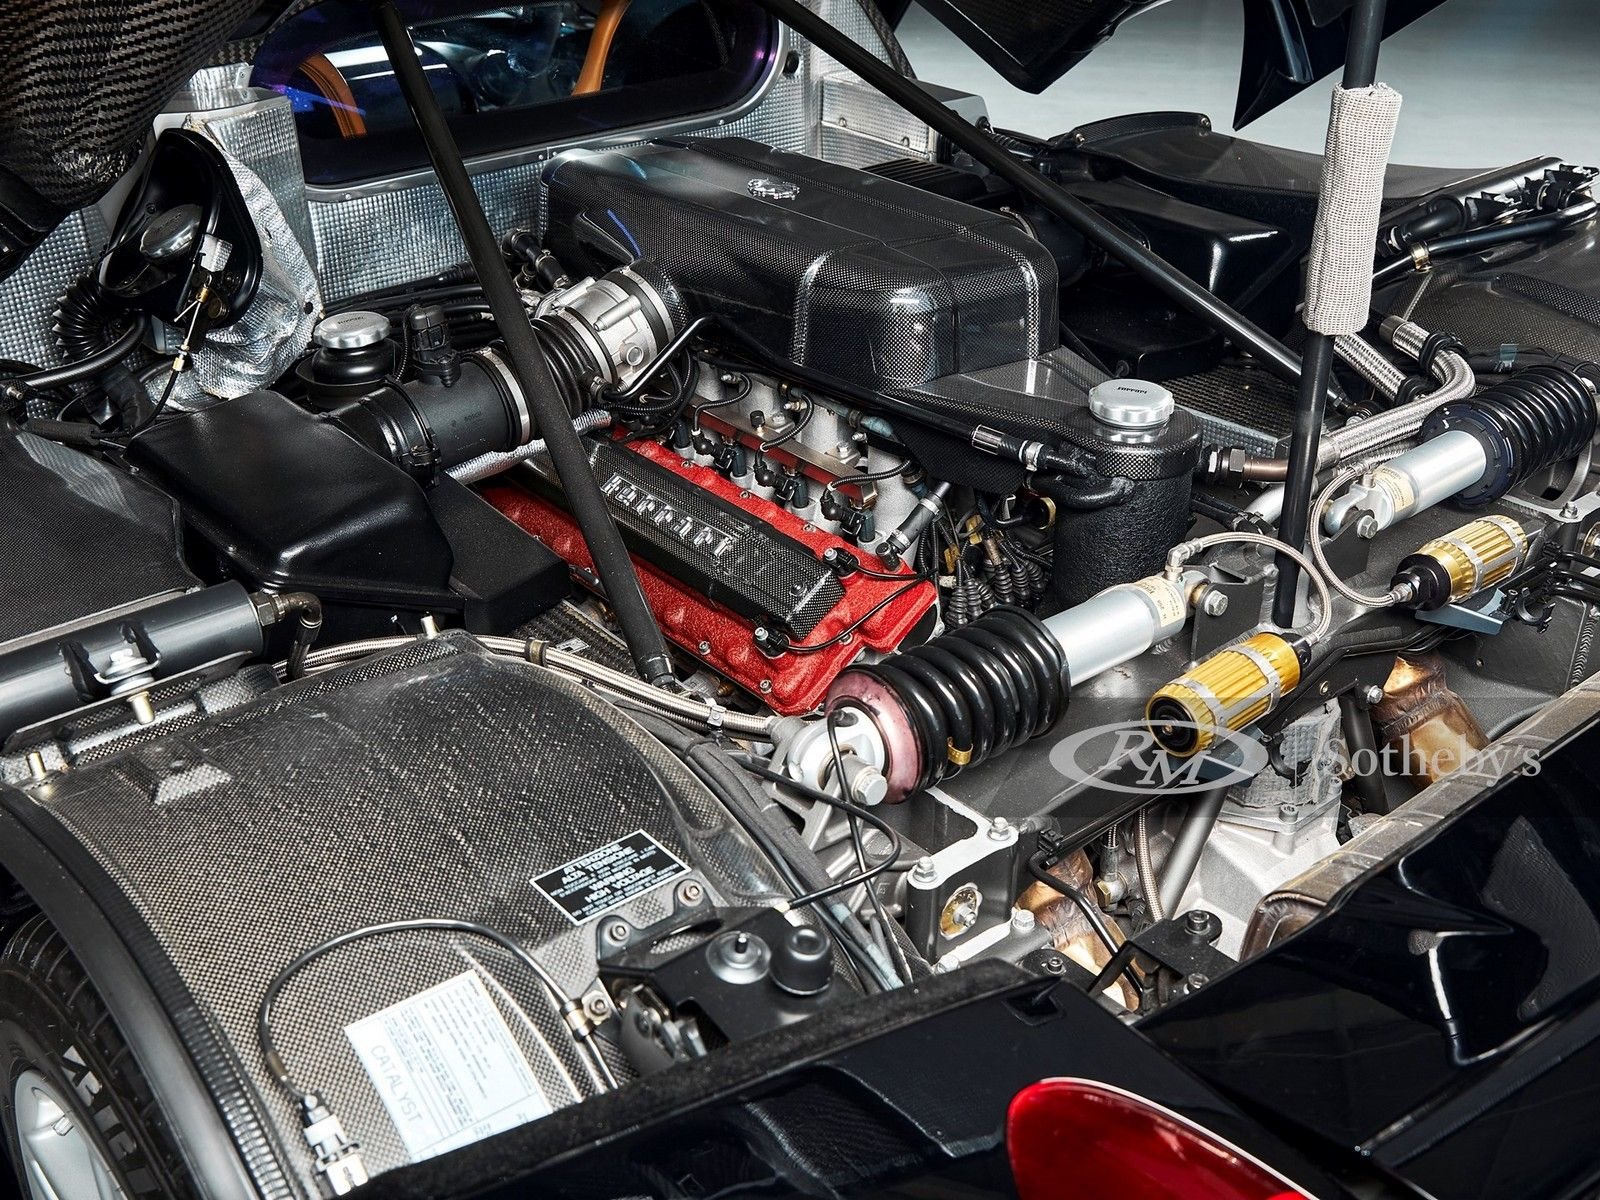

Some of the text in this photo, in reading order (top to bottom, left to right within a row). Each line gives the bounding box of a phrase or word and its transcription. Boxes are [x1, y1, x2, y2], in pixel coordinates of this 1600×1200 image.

[599, 472, 736, 556] Ferrari
[562, 870, 586, 884] ALTA
[585, 846, 635, 872] TENSIONE
[564, 844, 623, 874] ATTENZIONE
[584, 887, 611, 902] HIGH
[611, 866, 656, 889] VOLTAGE
[588, 867, 636, 891] WARNING
[370, 1044, 423, 1123] CATALYST
